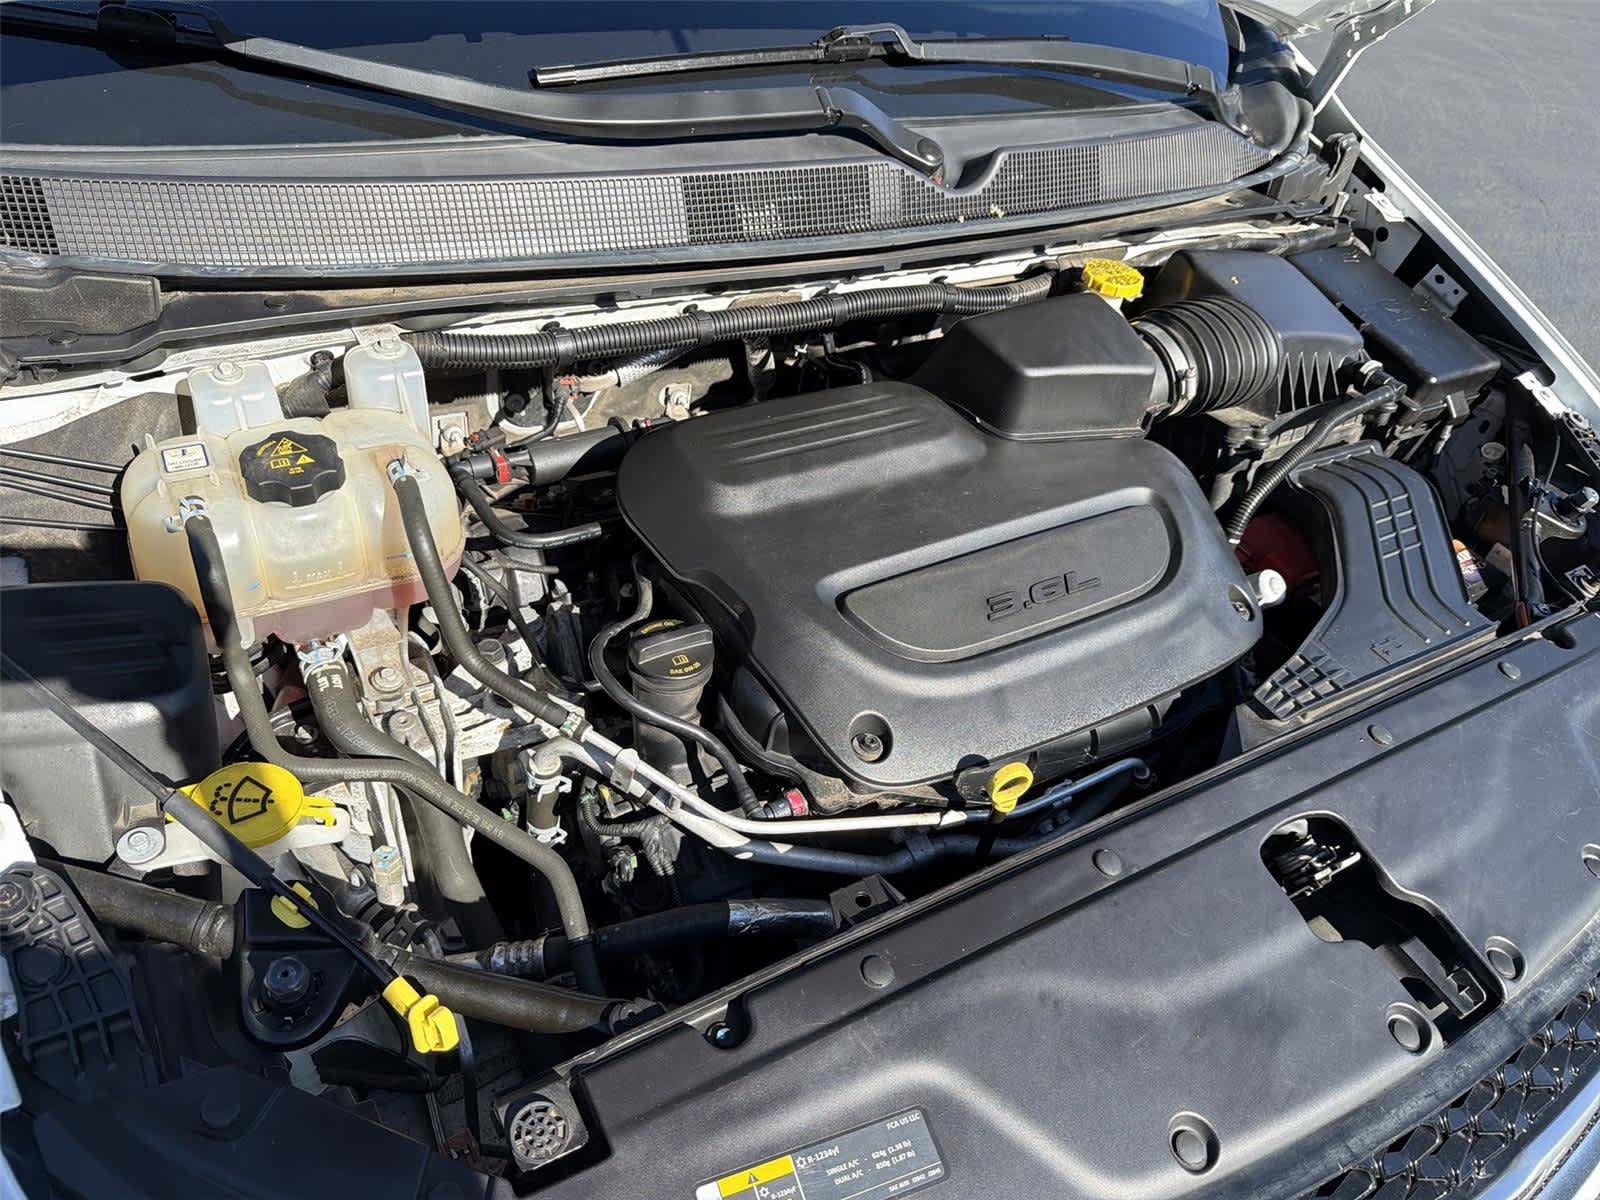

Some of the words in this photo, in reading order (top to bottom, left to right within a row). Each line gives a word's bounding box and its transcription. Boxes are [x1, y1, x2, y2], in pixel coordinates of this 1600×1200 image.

[983, 570, 1101, 622] 3.6L
[886, 1120, 900, 1131] FCA
[900, 1117, 908, 1126] US
[908, 1112, 921, 1123] LLC
[807, 1145, 840, 1163] R-1234yf
[847, 1158, 861, 1171] A/C
[834, 1174, 850, 1185] DUAL
[850, 1169, 864, 1181] A/C
